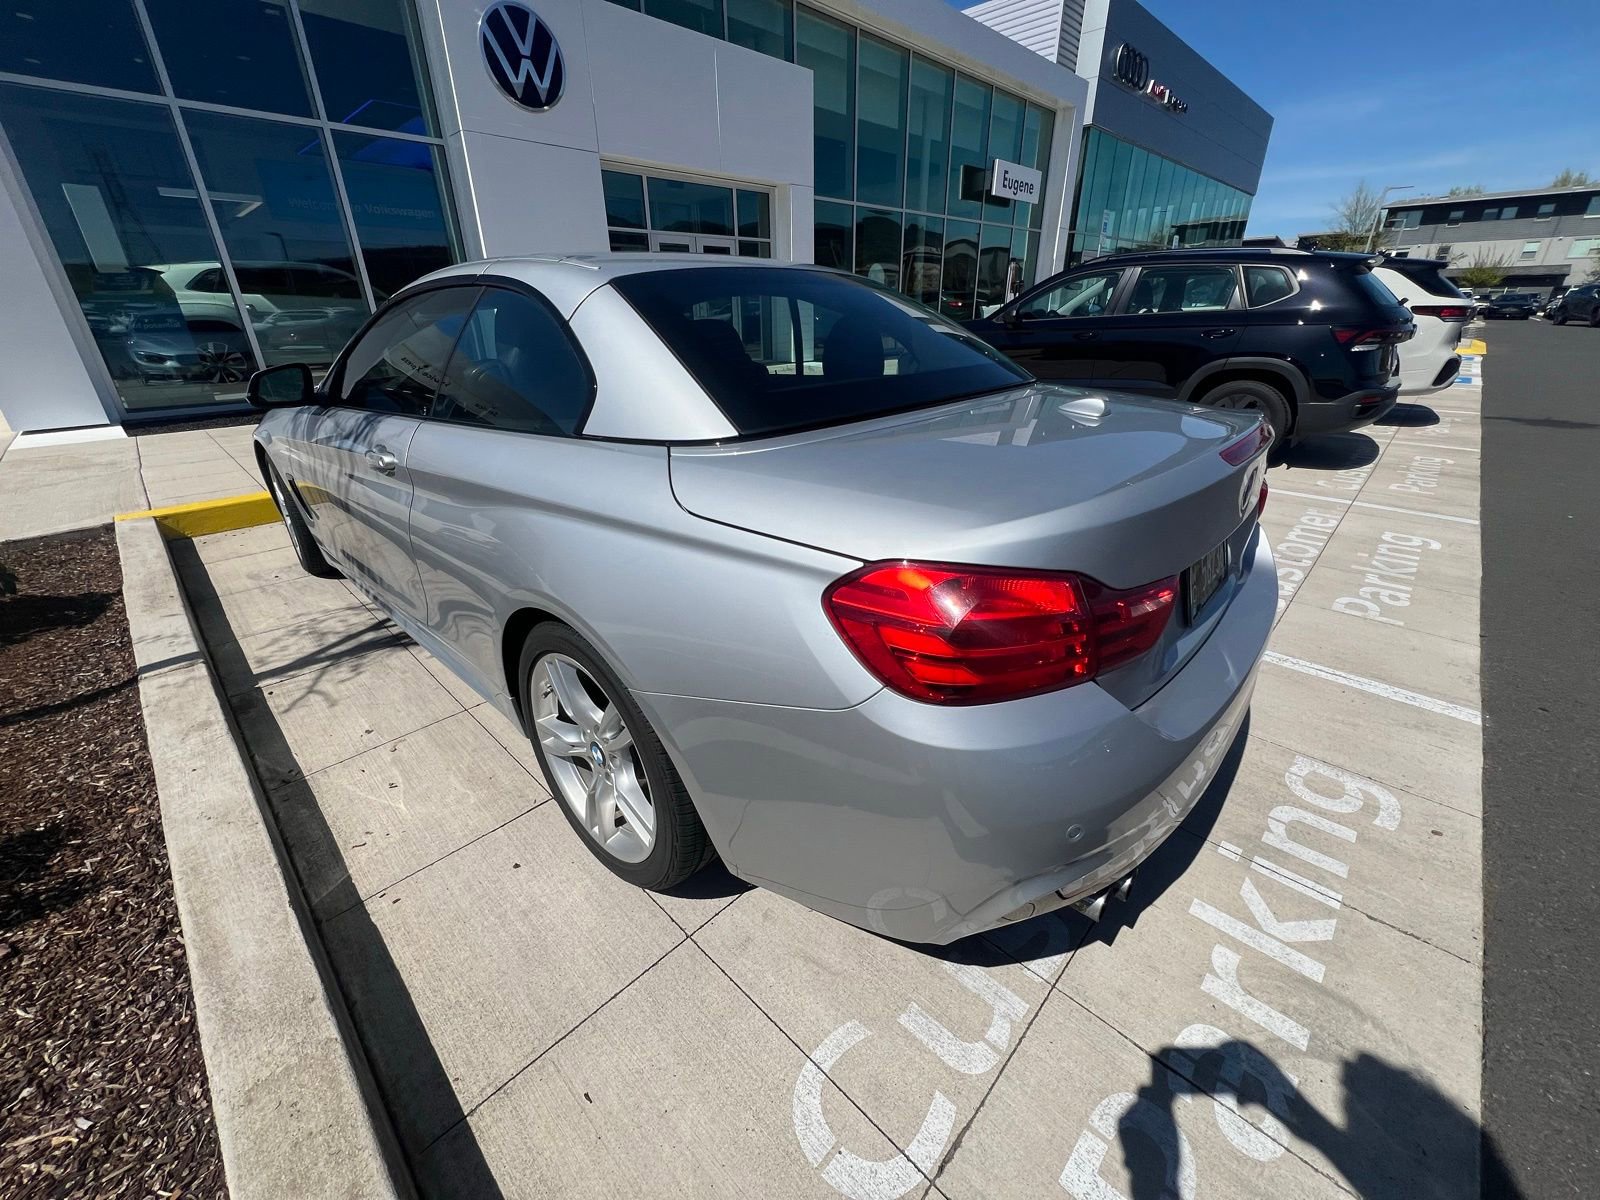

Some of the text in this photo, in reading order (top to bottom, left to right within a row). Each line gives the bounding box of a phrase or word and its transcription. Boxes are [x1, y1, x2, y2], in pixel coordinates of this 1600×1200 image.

[1002, 169, 1035, 196] Eugene
[363, 203, 436, 221] Volkswagen
[1388, 455, 1455, 496] Parking
[1331, 531, 1443, 627] Parking
[1058, 755, 1402, 1200] Parking
